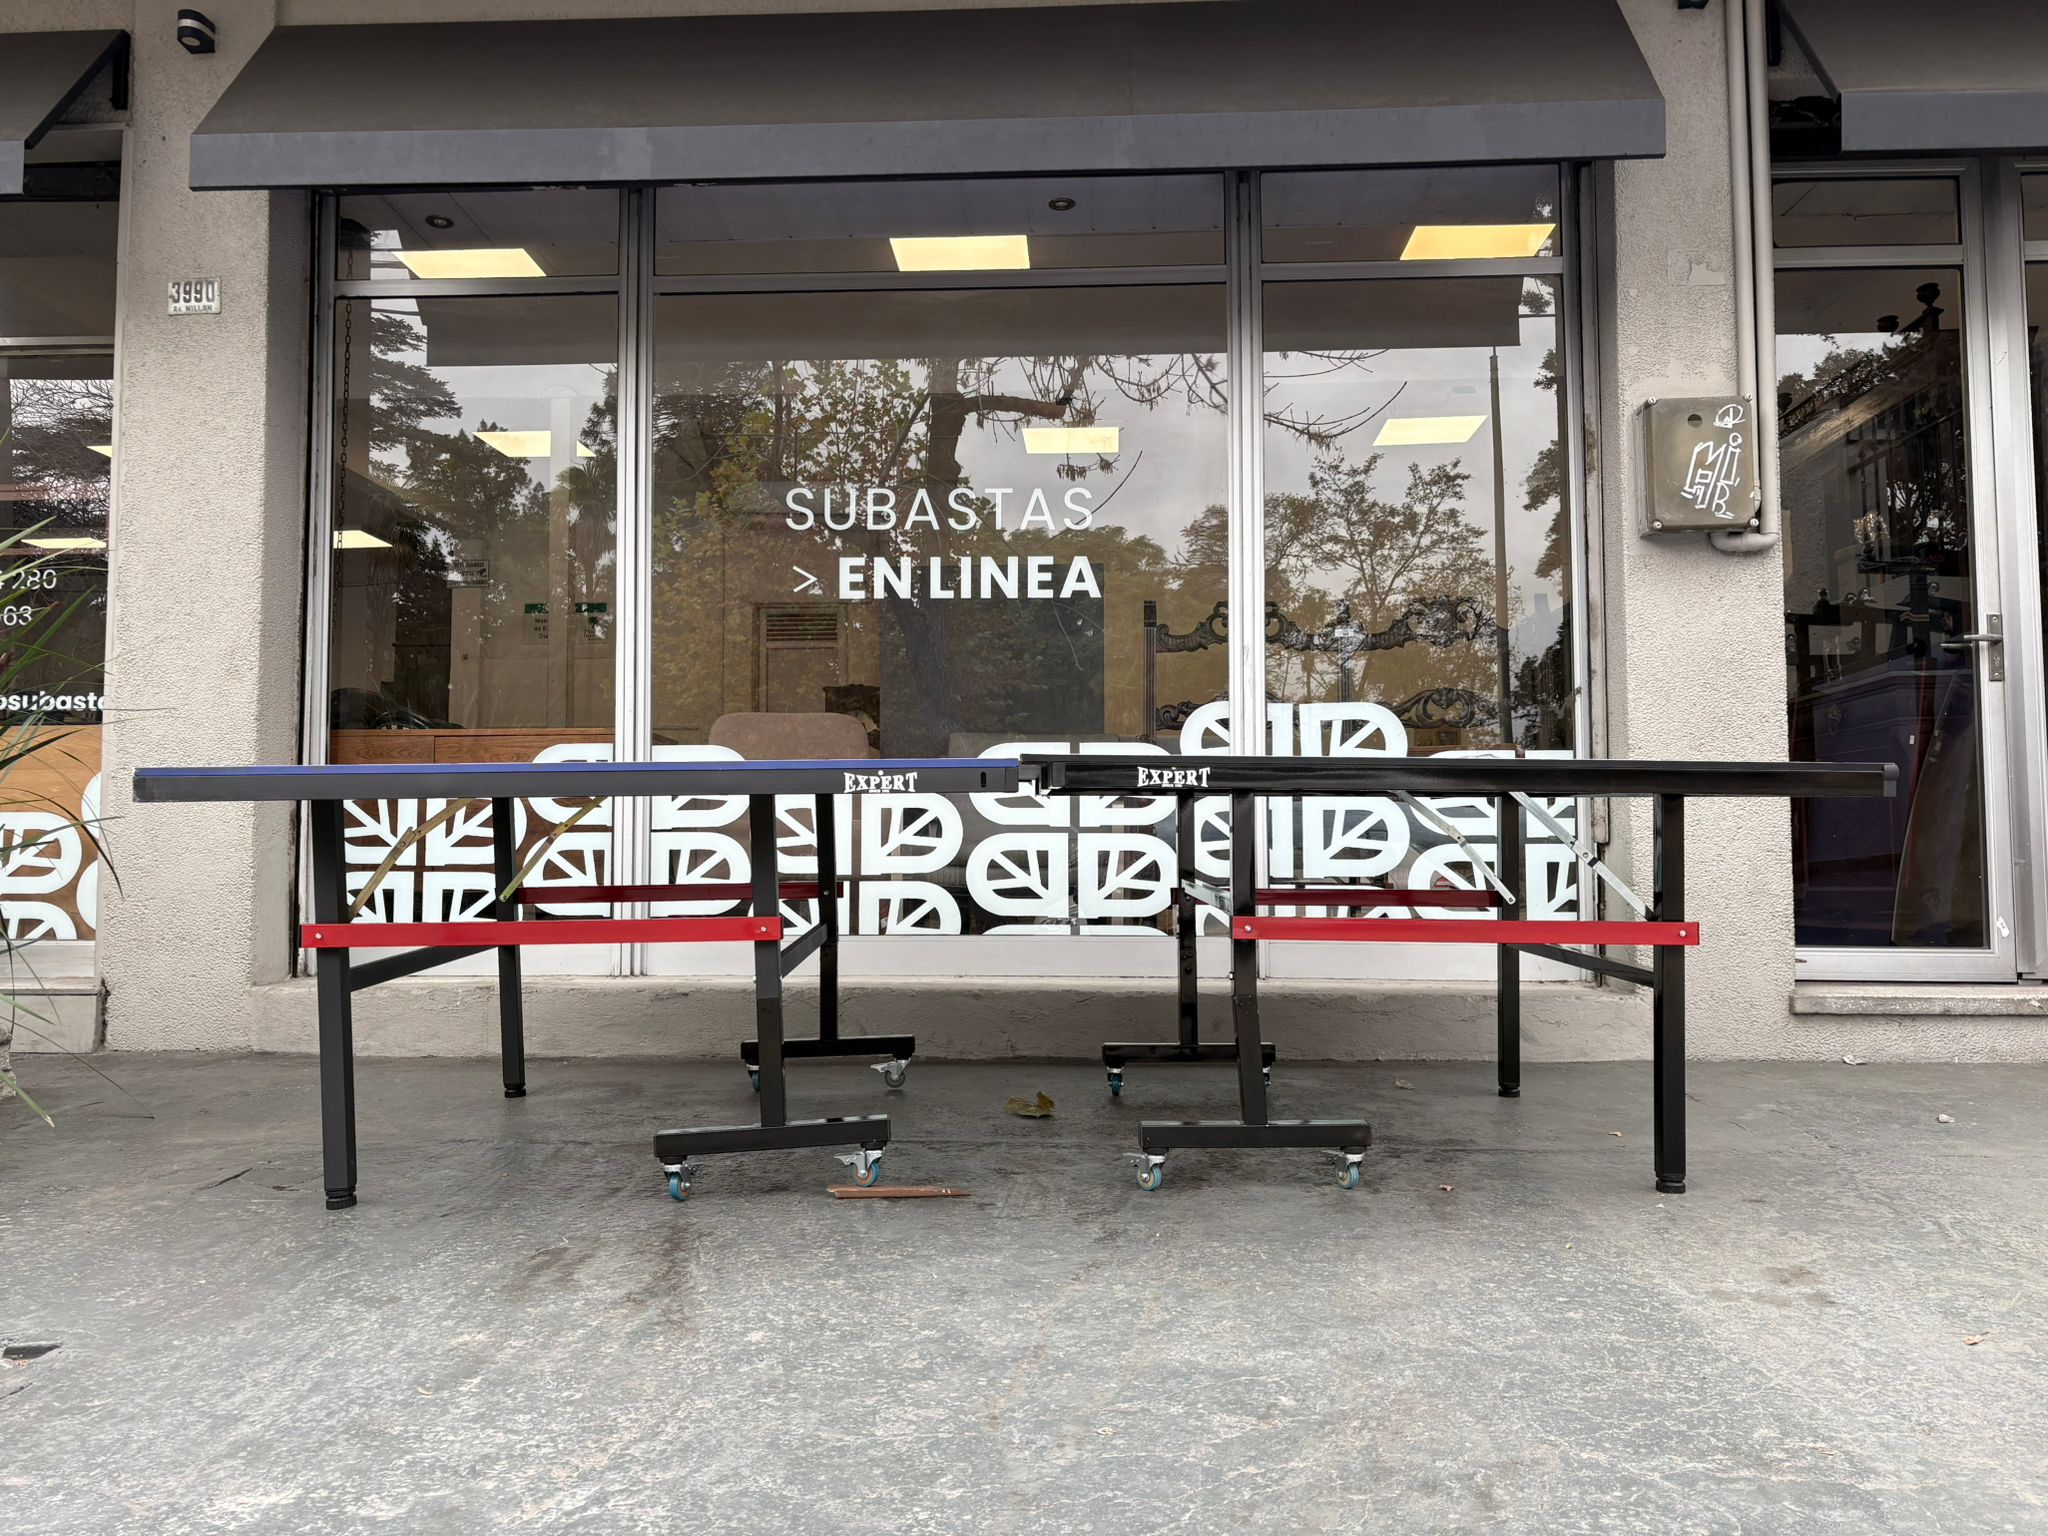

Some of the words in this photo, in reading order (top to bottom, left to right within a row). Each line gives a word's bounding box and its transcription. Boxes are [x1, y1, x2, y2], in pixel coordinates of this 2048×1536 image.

[172, 280, 215, 303] 3990
[785, 487, 1093, 531] SUBASTAS
[838, 556, 912, 600] EN
[929, 555, 1103, 600] LINEA
[843, 770, 918, 793] EXPERT
[1137, 766, 1211, 788] EXPERT
